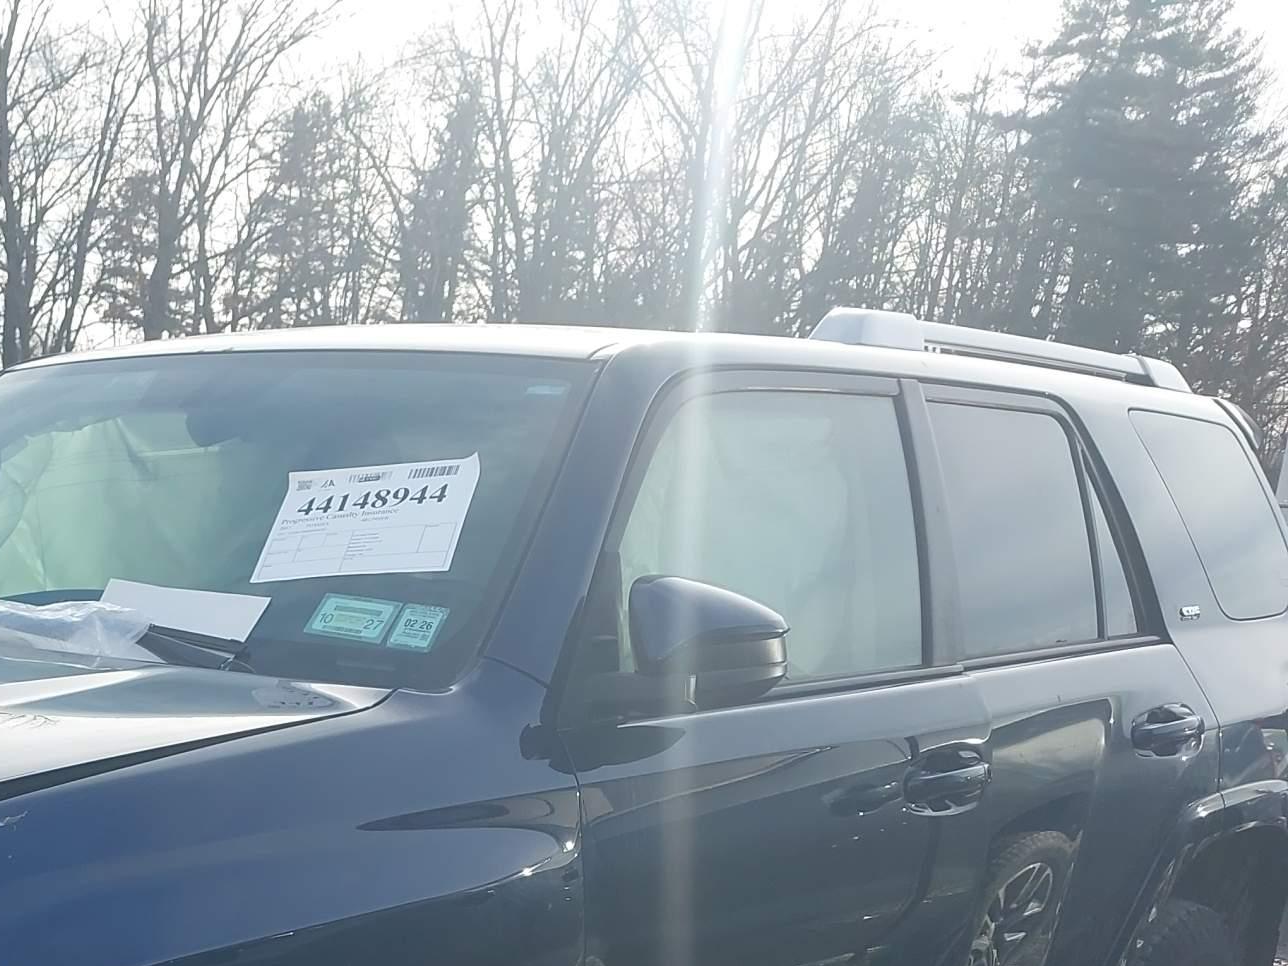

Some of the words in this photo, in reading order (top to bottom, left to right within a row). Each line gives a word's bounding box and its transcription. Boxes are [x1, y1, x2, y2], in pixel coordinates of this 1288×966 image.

[297, 483, 449, 516] 44148944
[363, 619, 384, 631] 27
[404, 618, 418, 628] 02
[419, 621, 434, 631] 26
